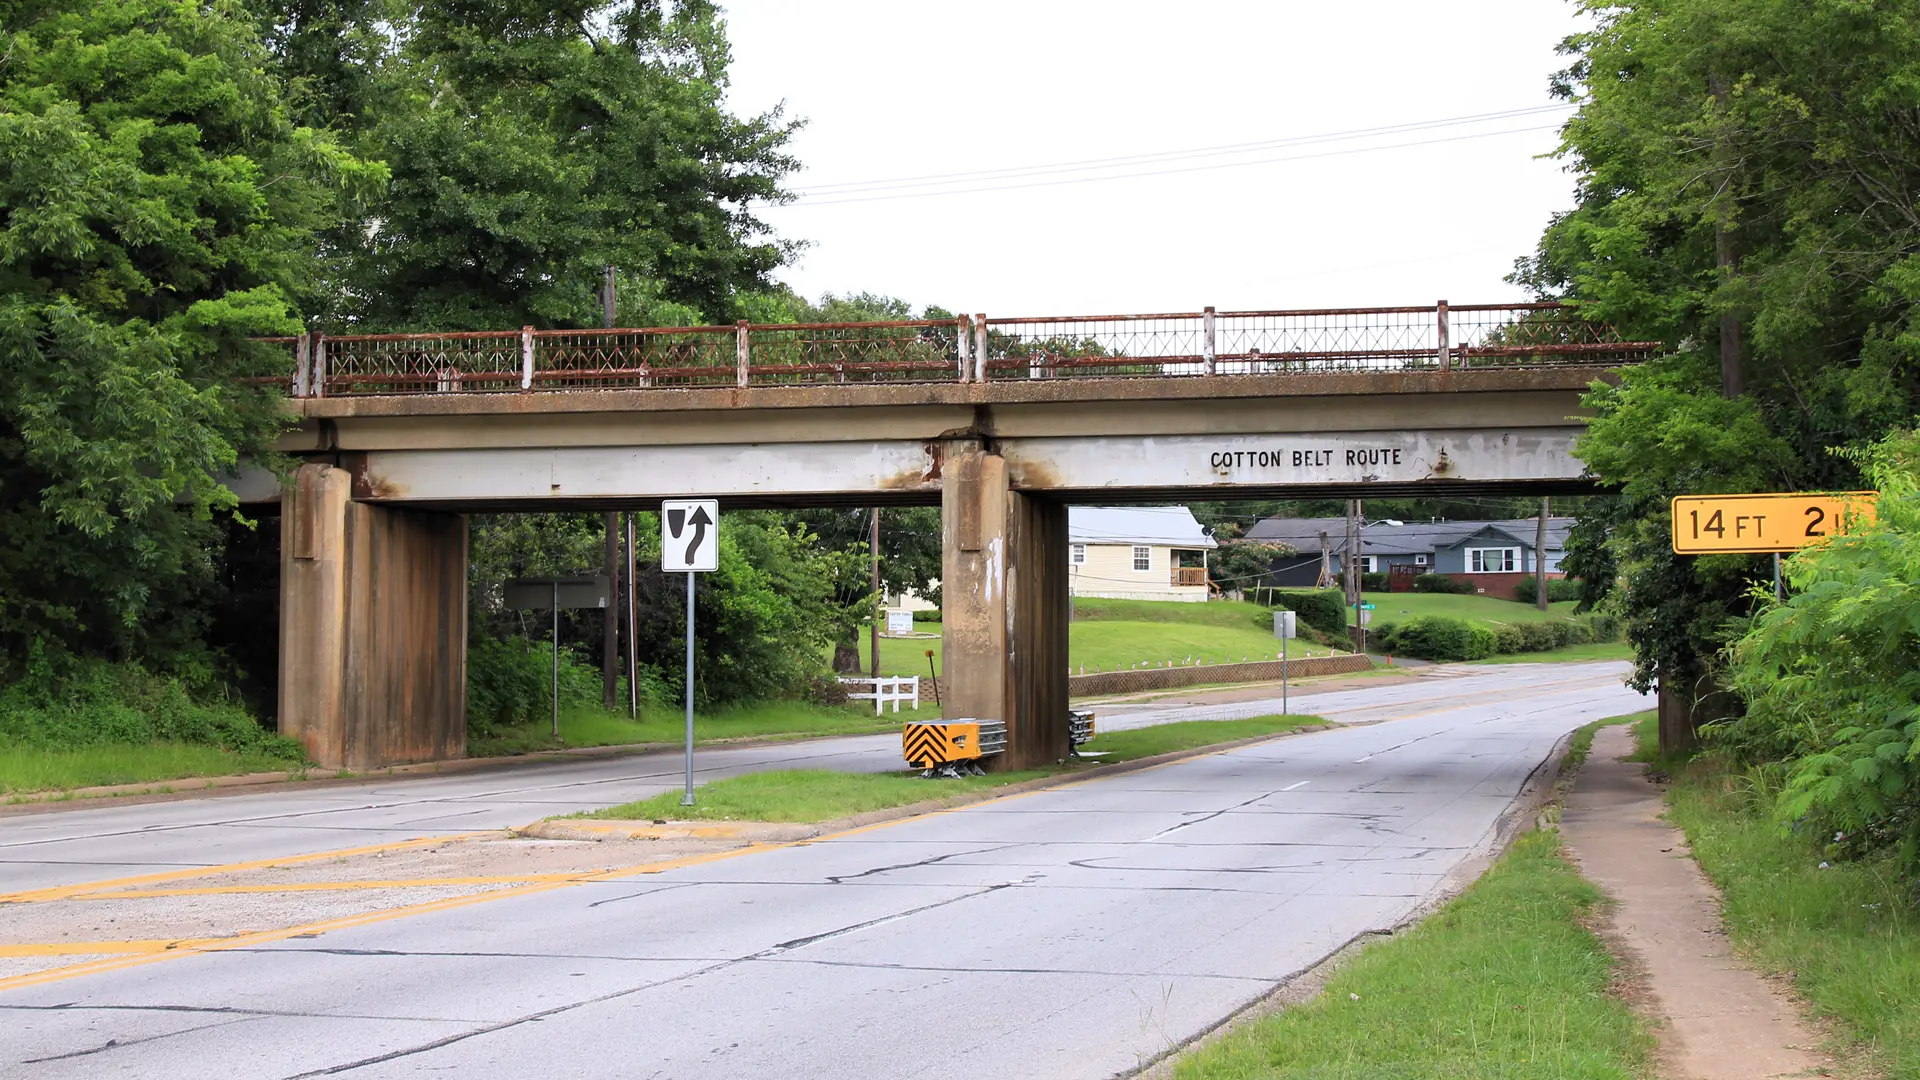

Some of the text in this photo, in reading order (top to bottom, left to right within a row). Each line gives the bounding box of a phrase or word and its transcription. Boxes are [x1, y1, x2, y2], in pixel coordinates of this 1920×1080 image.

[1210, 448, 1402, 468] COTTON BELT ROUTE
[1690, 509, 1726, 540] 14
[1736, 515, 1767, 539] FT
[1804, 506, 1826, 537] 2
